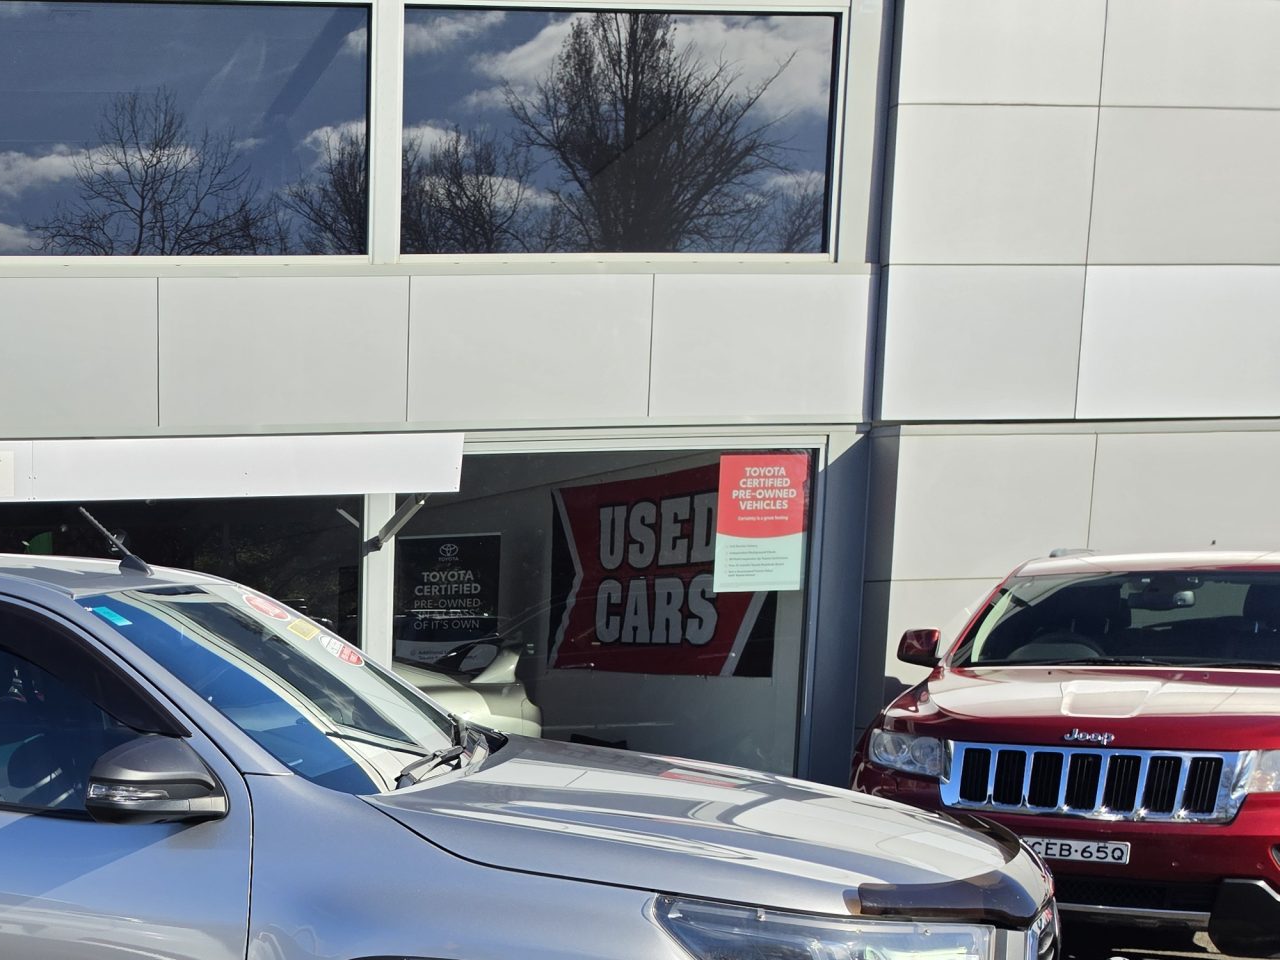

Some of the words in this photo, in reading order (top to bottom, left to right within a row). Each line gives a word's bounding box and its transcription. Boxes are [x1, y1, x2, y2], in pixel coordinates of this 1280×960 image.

[745, 466, 786, 477] TOYOTA
[739, 478, 791, 488] CERTIFIED
[731, 488, 797, 499] PRE-OWNED
[739, 500, 789, 510] VEHICLES
[599, 491, 719, 570] USED
[421, 570, 474, 583] TOYOTA
[414, 583, 481, 596] CERTIFIED
[414, 598, 481, 609] PRE-OWNED
[595, 573, 718, 645] CARS
[413, 621, 429, 630] OF
[431, 620, 449, 630] IT'S
[451, 619, 480, 629] OWN
[1064, 728, 1115, 746] Jeep
